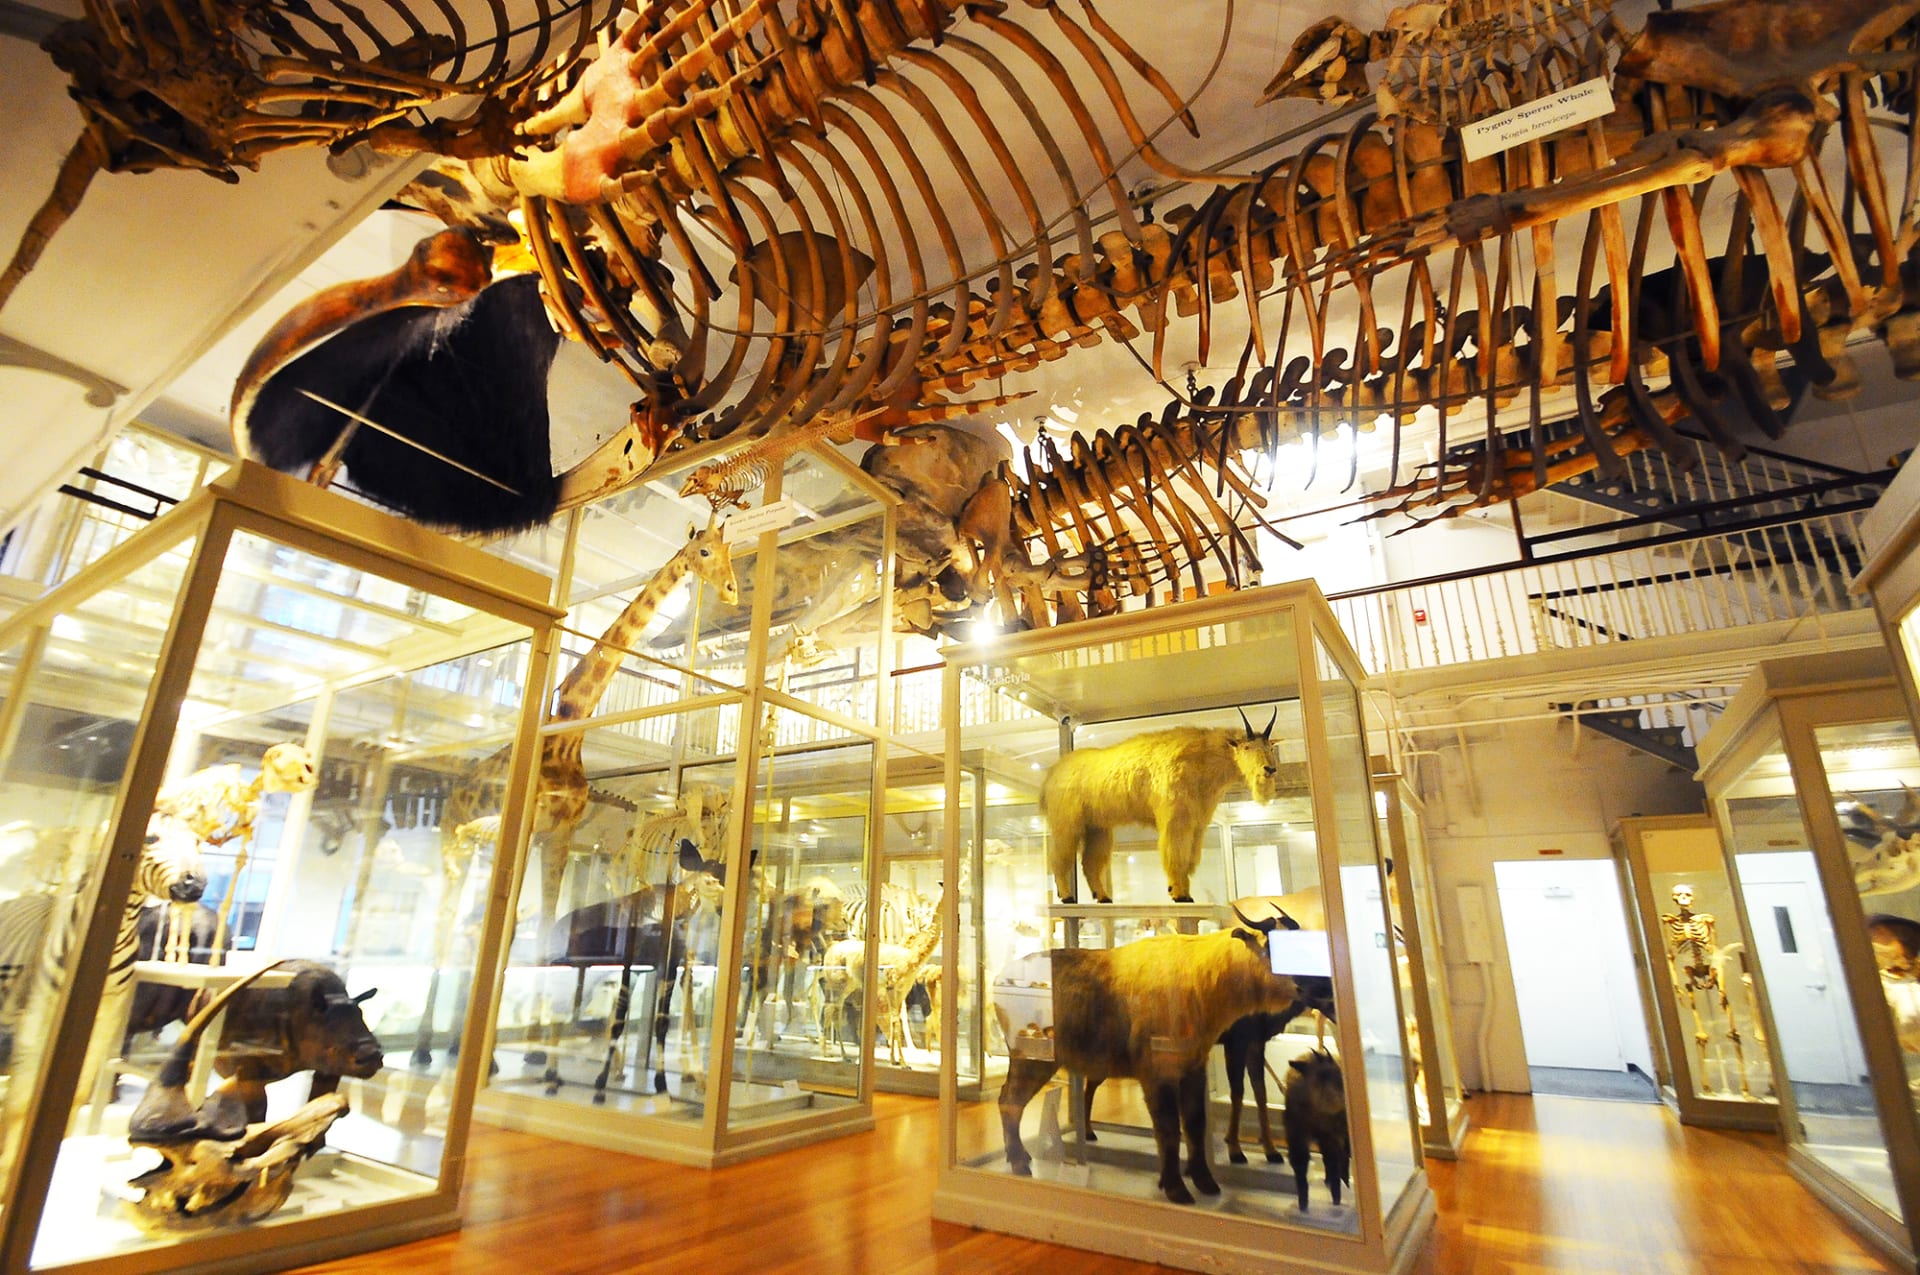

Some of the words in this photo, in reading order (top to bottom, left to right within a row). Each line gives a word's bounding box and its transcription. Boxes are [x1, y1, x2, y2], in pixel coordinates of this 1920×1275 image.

[1477, 118, 1513, 134] Pygmy
[1517, 103, 1553, 120] Sperm
[1557, 88, 1594, 104] Whale
[1501, 128, 1529, 142] Kogia
[1531, 111, 1577, 131] breviceps
